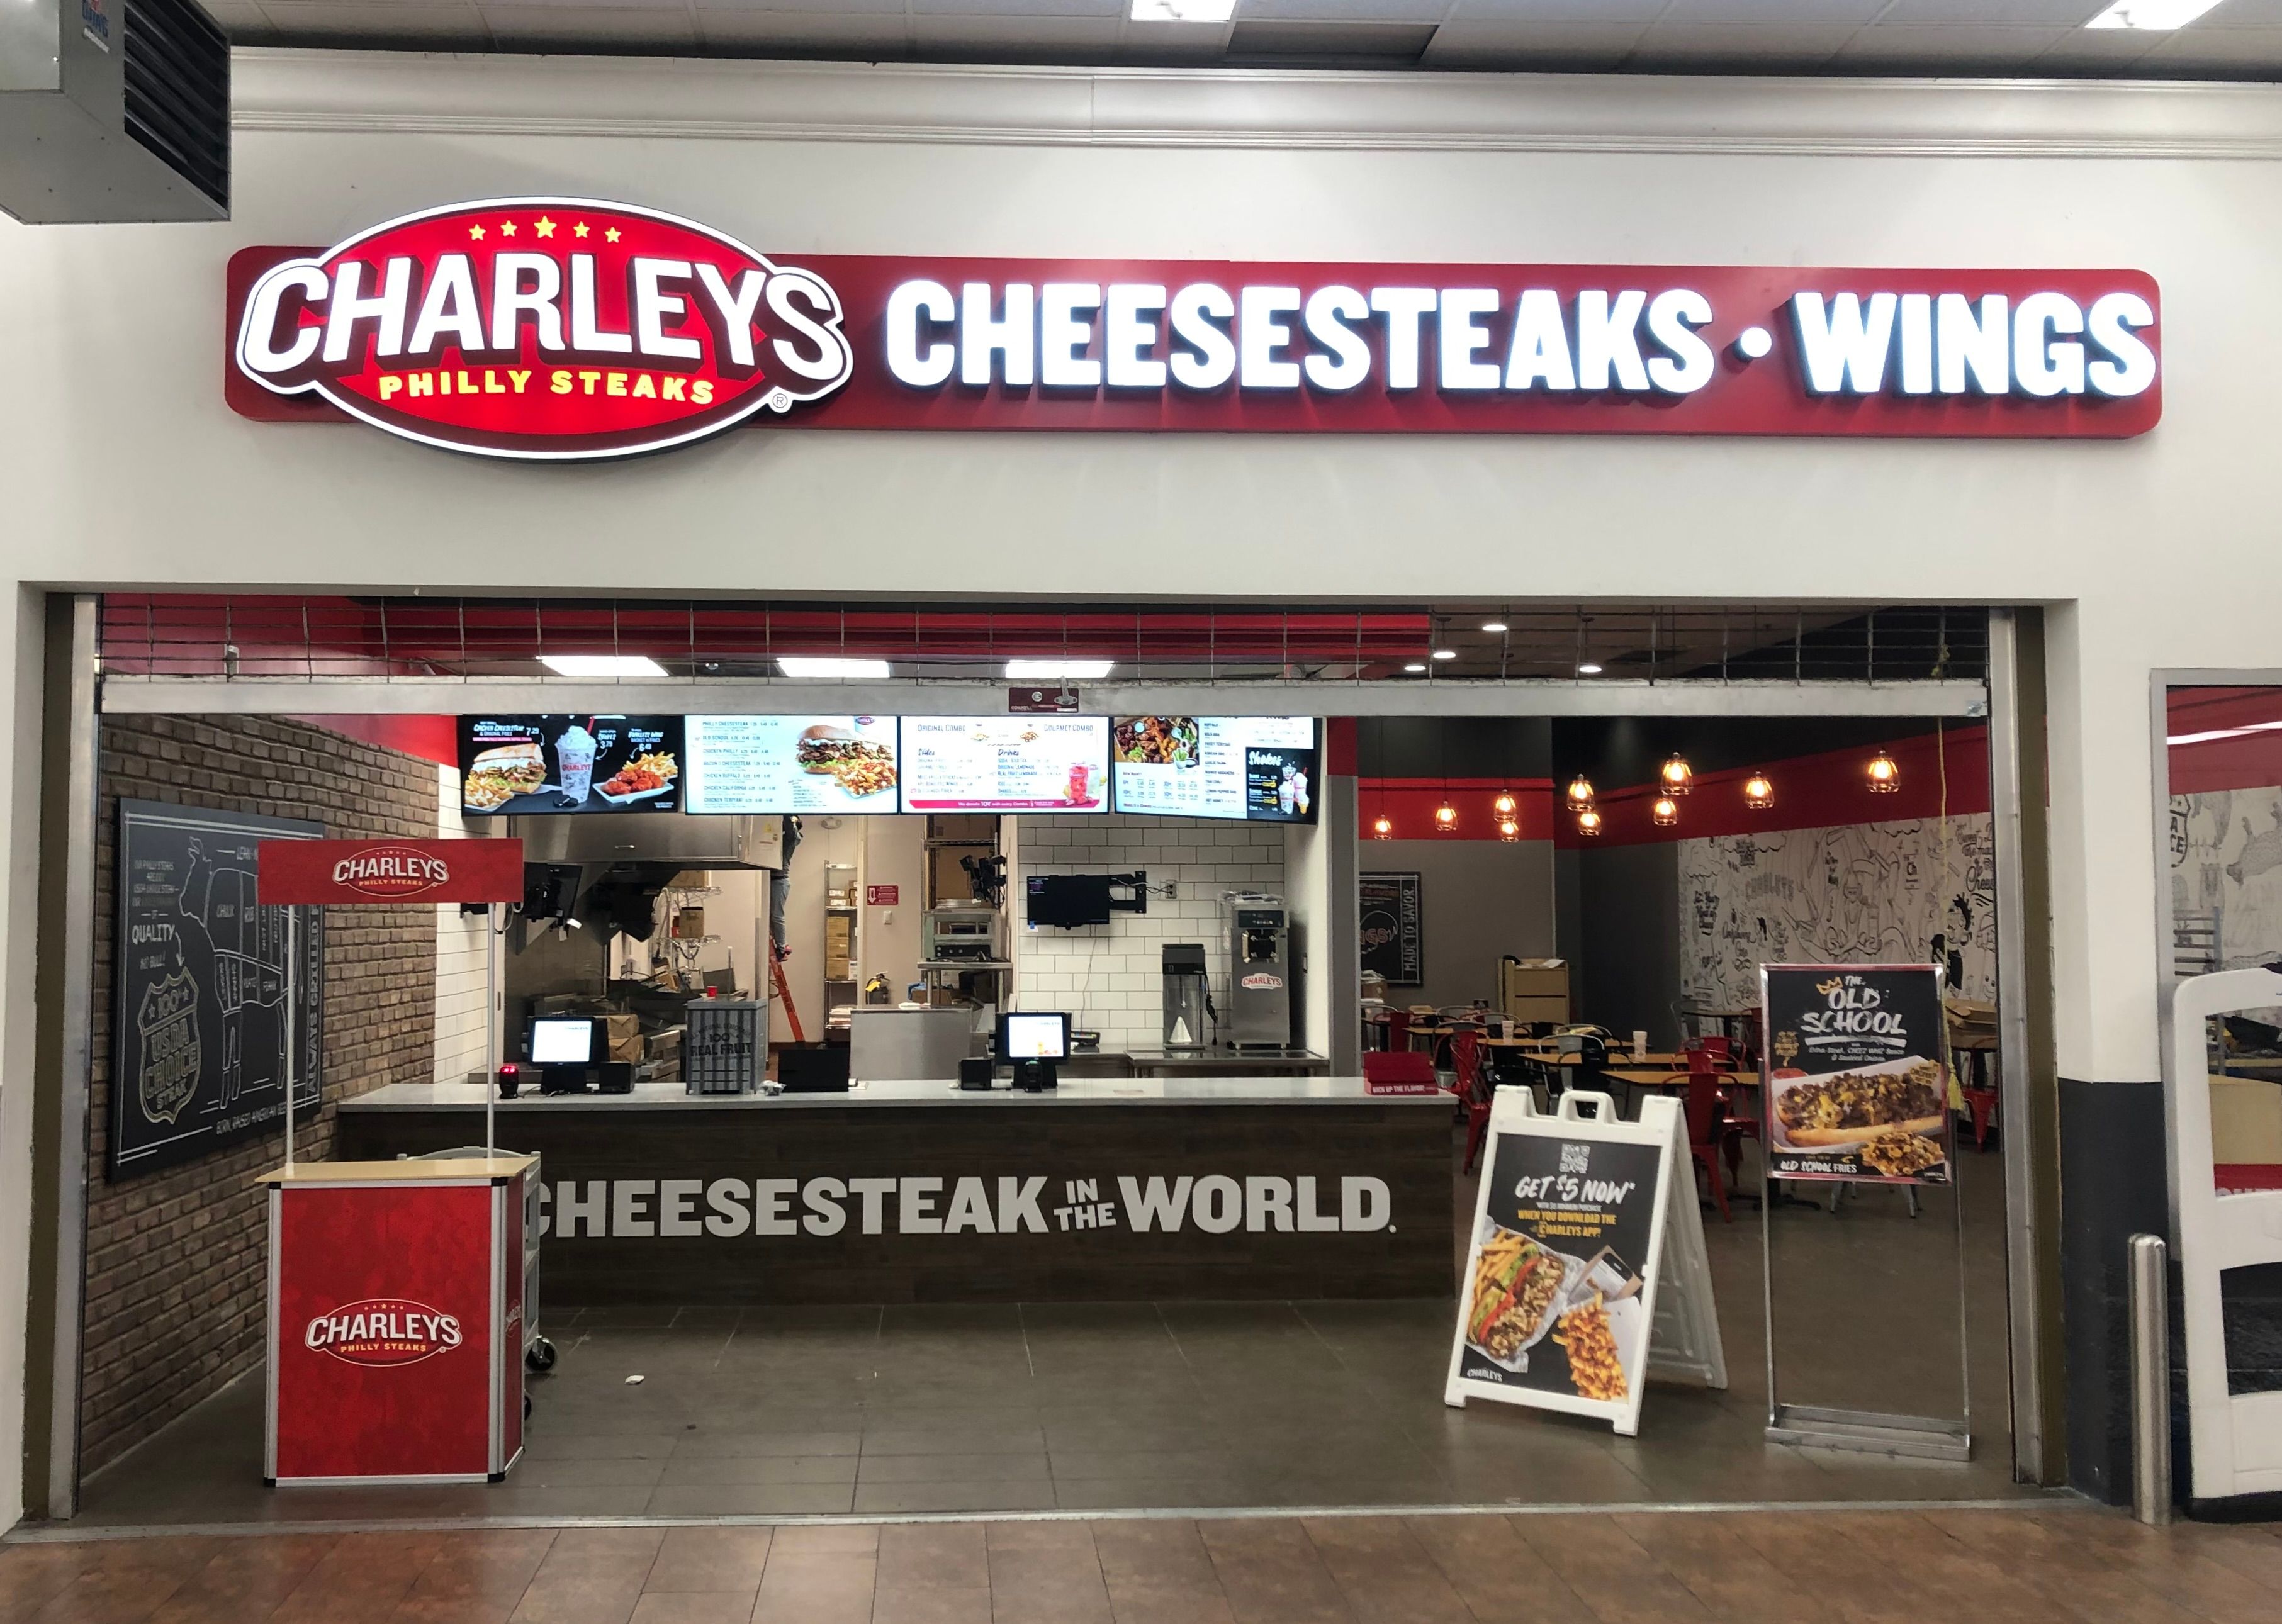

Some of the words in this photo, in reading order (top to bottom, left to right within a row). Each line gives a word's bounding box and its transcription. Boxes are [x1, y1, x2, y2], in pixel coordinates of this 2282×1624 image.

[253, 253, 843, 381] CHARLEYS
[886, 281, 1715, 393] CHEESESTEAKS
[1794, 291, 2157, 396] WINGS
[379, 369, 532, 400] PHILLY
[551, 371, 714, 405] STEAKS
[334, 858, 448, 882] CHARLEYS
[1403, 886, 1415, 924] SAVOR.
[132, 924, 175, 944] QUALITY
[1403, 926, 1416, 940] TO
[1404, 944, 1417, 972] MADE
[1243, 977, 1283, 986] CHARLEYS
[1828, 987, 1880, 1010] OLD
[1800, 1010, 1908, 1035] SCHOOL
[150, 1017, 189, 1062] USDA
[691, 1044, 718, 1056] REAL
[721, 1043, 753, 1055] FRUIT
[144, 1043, 198, 1100] CHOICE
[157, 1077, 188, 1110] STEAK
[1780, 1160, 1797, 1171] OLD
[1833, 1163, 1857, 1173] FRIES
[1066, 1178, 1098, 1204] IN
[1515, 1175, 1555, 1199] GET
[1556, 1173, 1579, 1202] $5
[1054, 1202, 1116, 1231] THE
[1117, 1174, 1397, 1233] WORLD.
[307, 1313, 461, 1347] CHARLEYS
[340, 1343, 379, 1353] PHILLY
[384, 1343, 427, 1352] STEAKS
[1466, 1368, 1503, 1382] CHARLEYS
